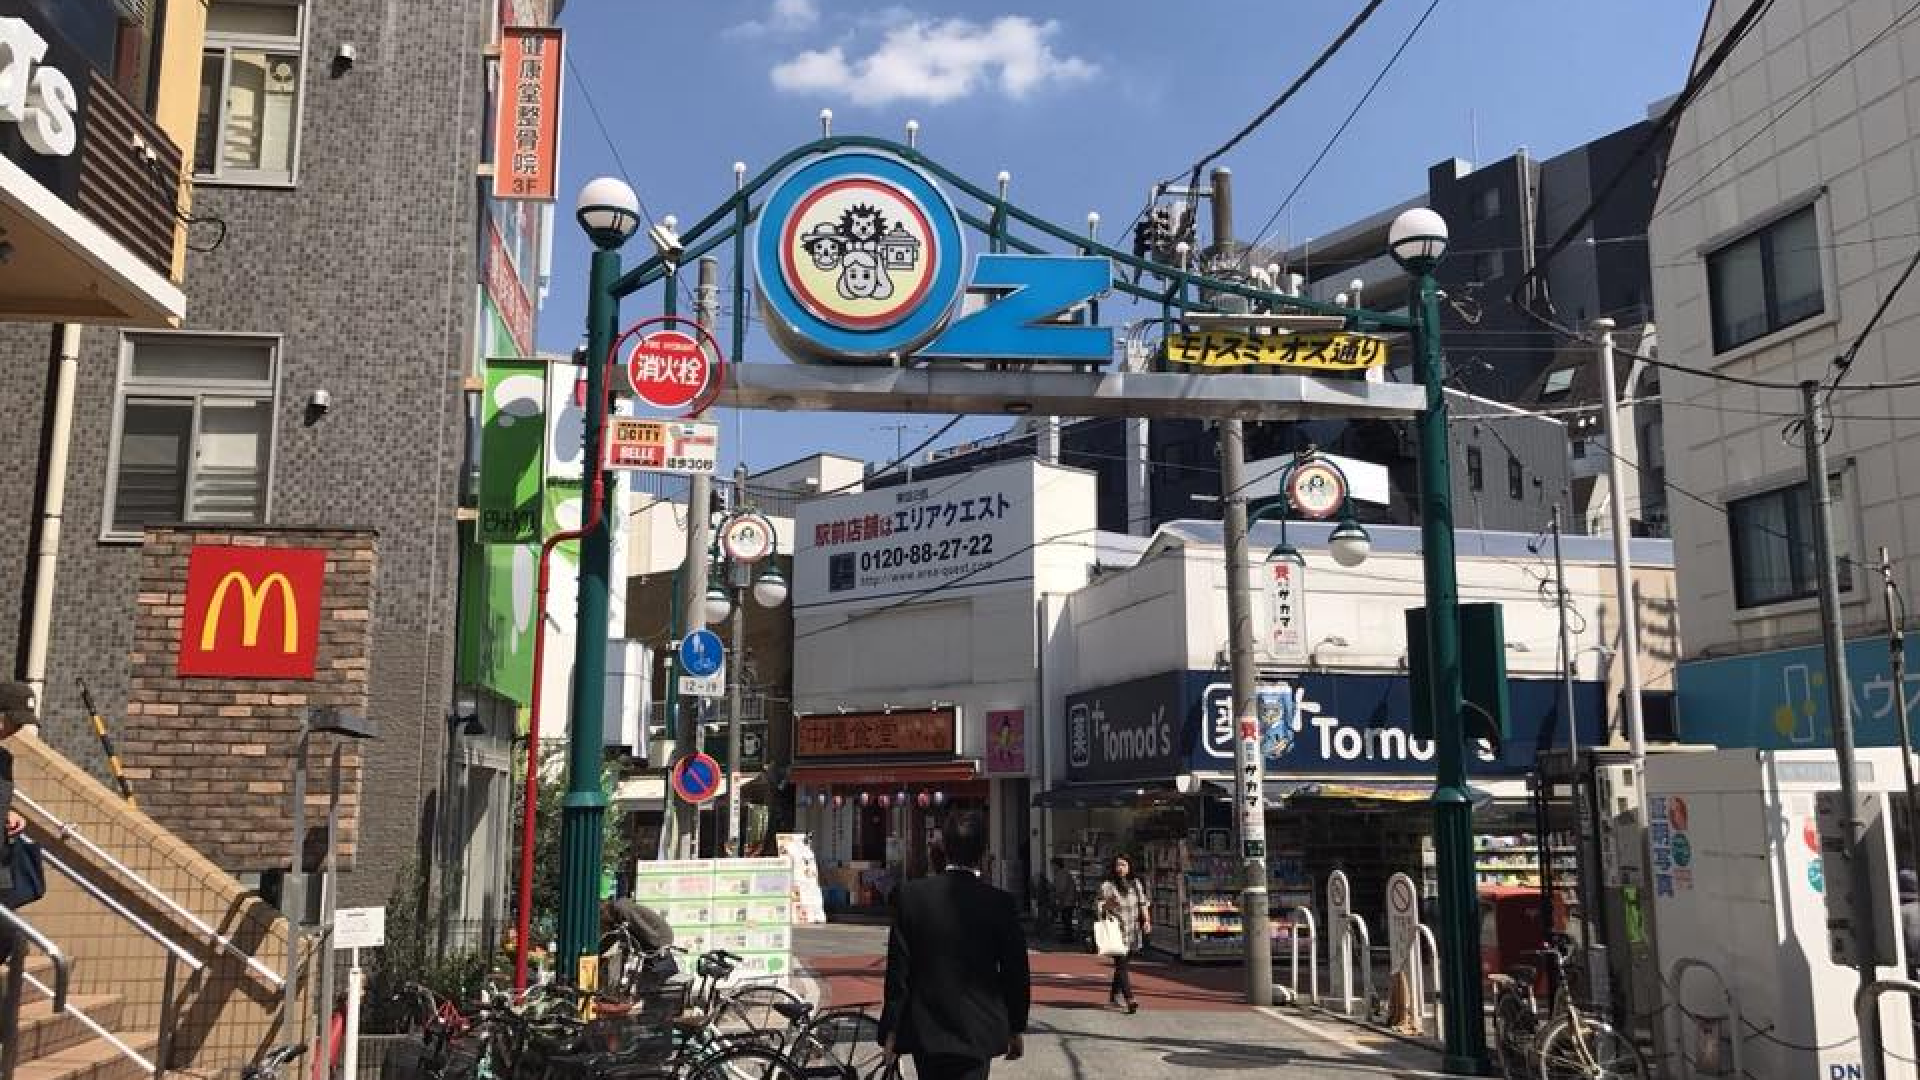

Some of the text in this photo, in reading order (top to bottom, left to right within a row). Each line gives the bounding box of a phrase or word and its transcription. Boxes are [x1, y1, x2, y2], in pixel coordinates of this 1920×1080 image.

[512, 178, 538, 194] 3F
[636, 353, 702, 386] 消火栓
[814, 492, 1011, 547] 駅前店舗はエリアクエスト
[1101, 703, 1171, 763] Tomod's
